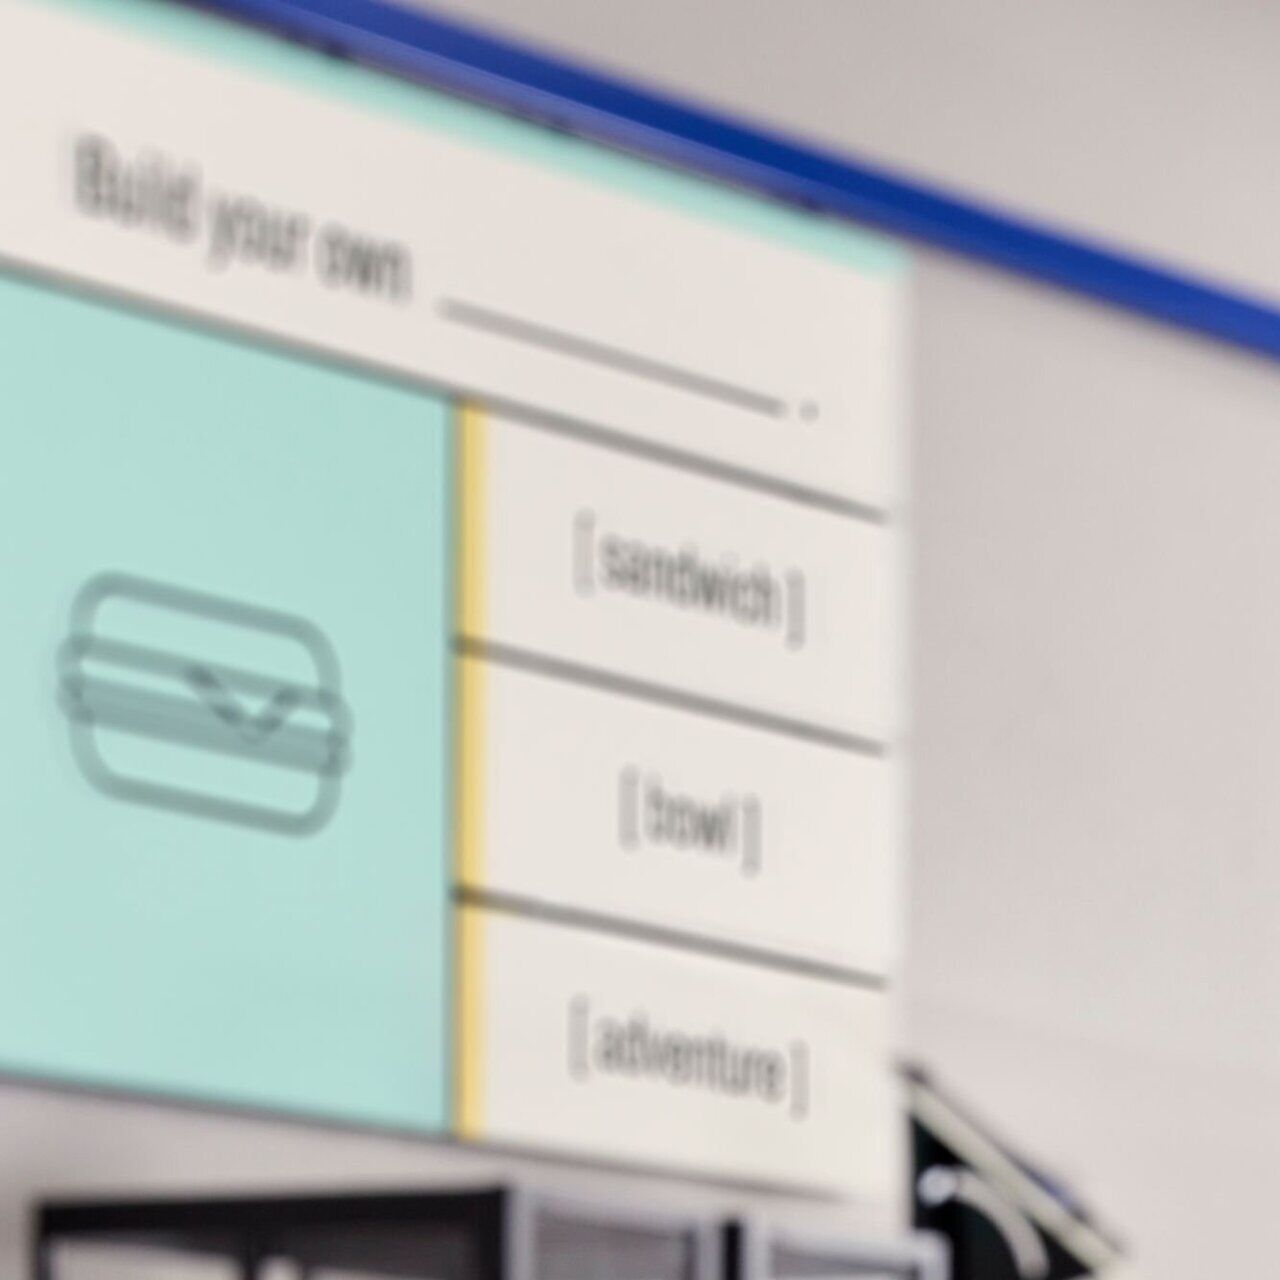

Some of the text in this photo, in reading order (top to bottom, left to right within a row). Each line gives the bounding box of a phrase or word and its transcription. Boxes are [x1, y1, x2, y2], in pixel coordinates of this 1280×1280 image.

[70, 132, 413, 303] Build your own
